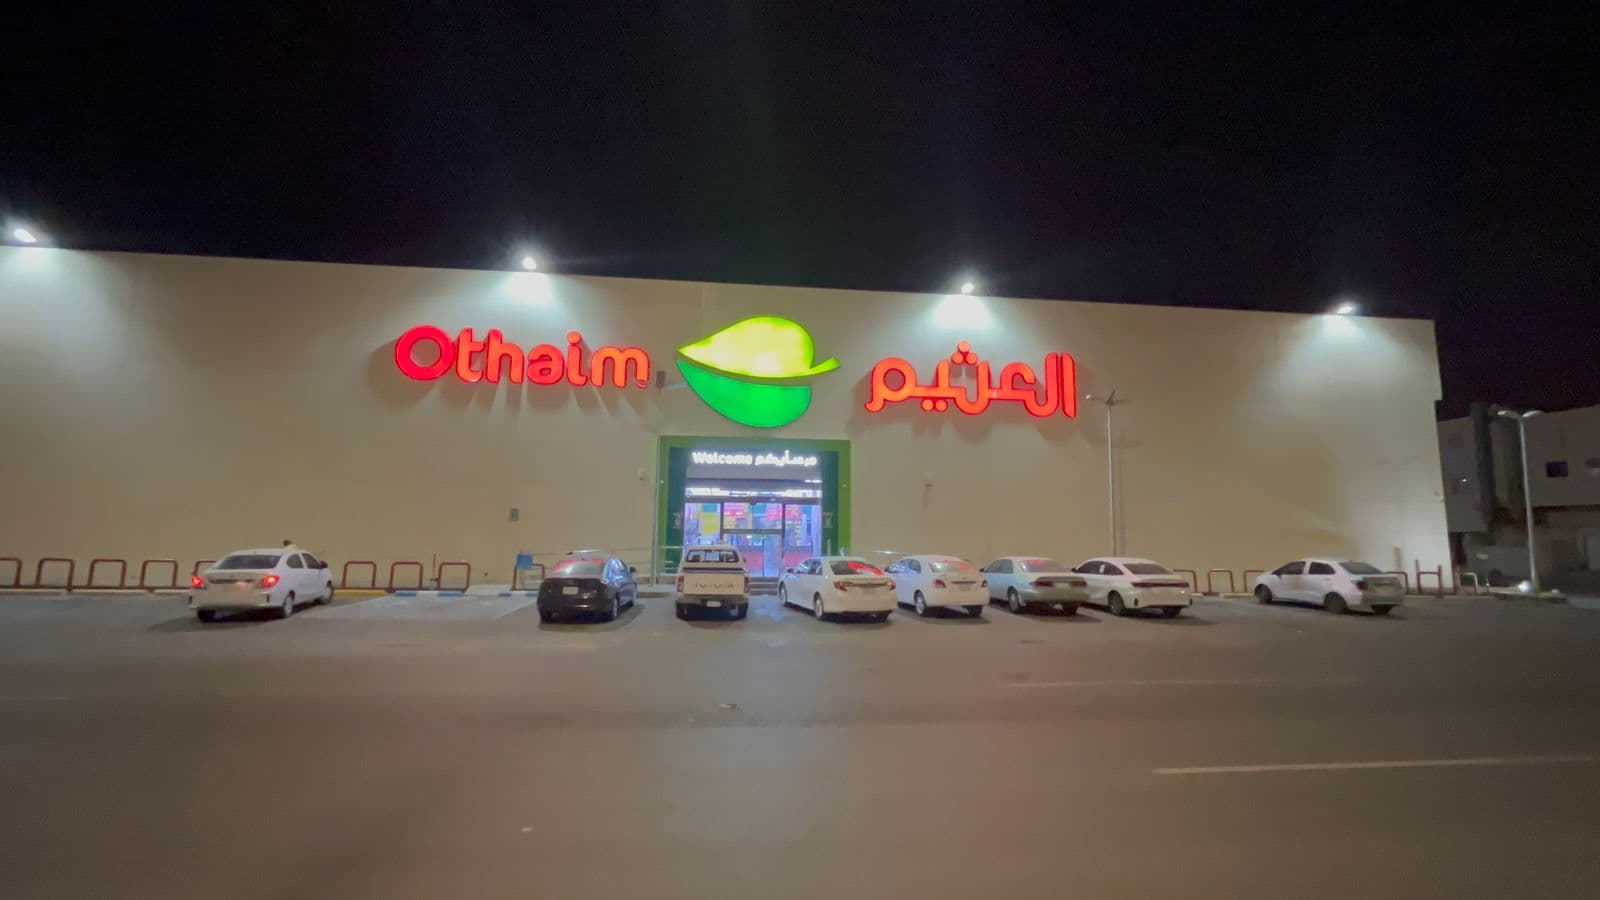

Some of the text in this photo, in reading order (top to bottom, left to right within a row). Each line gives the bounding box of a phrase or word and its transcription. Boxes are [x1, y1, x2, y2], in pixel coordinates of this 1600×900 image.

[395, 325, 650, 389] Othaim
[864, 341, 1077, 418] العثيم
[692, 452, 753, 465] Welcome
